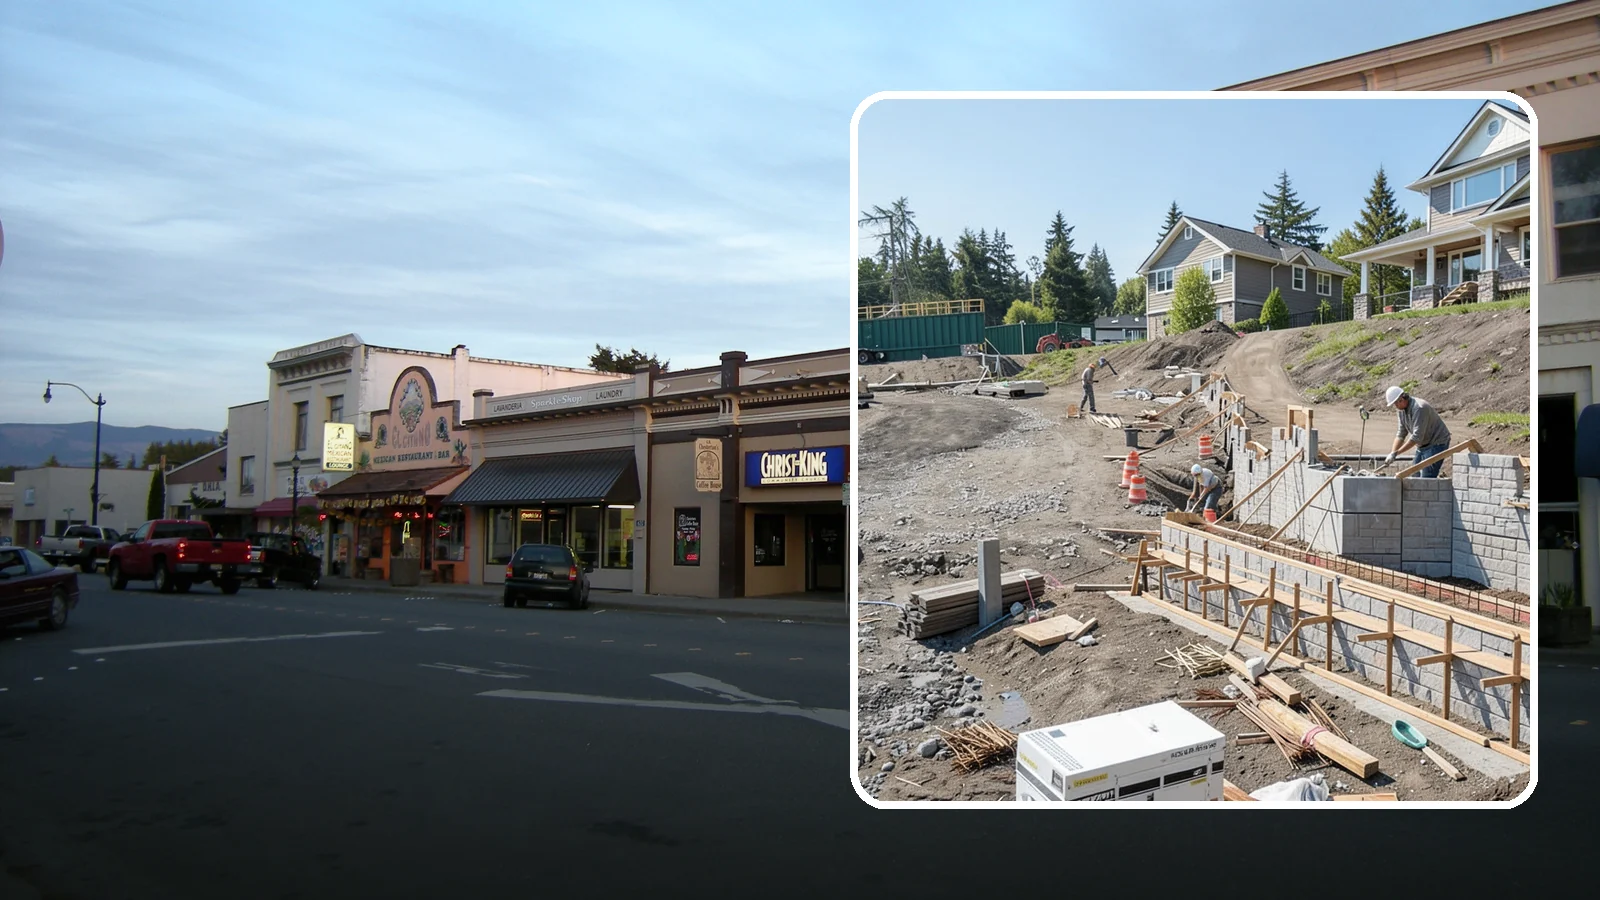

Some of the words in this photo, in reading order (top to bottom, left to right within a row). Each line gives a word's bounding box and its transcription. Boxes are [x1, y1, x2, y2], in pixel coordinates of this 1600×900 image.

[493, 401, 523, 413] LAVANDERIA
[531, 397, 561, 409] Sparkle
[561, 394, 582, 405] Shop
[595, 388, 623, 400] LAUNDRY
[373, 455, 396, 464] MEXICAN
[397, 451, 433, 462] RESTAURANT
[438, 450, 450, 459] BAR
[760, 452, 797, 478] CHRIST
[799, 450, 827, 476] KING
